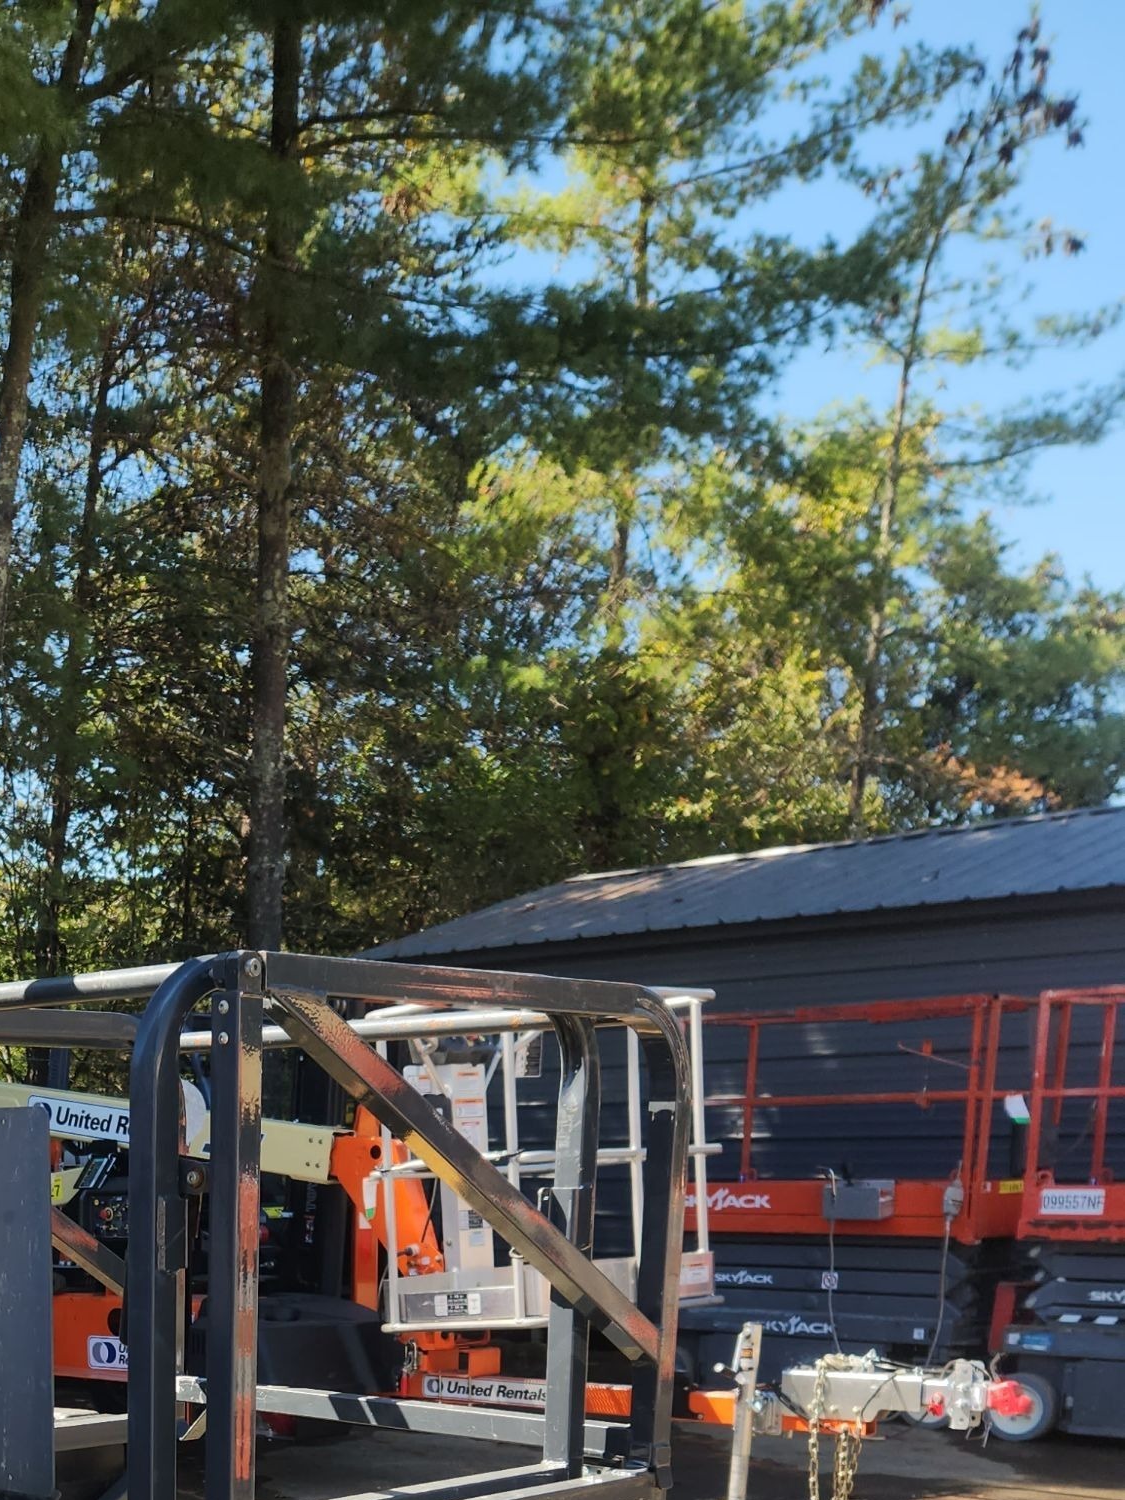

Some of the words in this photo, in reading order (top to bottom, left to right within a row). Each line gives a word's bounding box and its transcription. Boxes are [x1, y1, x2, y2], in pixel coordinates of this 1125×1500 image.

[56, 1106, 113, 1133] United
[715, 1270, 774, 1285] SKYJACK
[1089, 1289, 1125, 1304] SKY
[762, 1315, 834, 1335] KYJACK
[446, 1380, 493, 1397] United
[496, 1384, 547, 1402] Rentals
